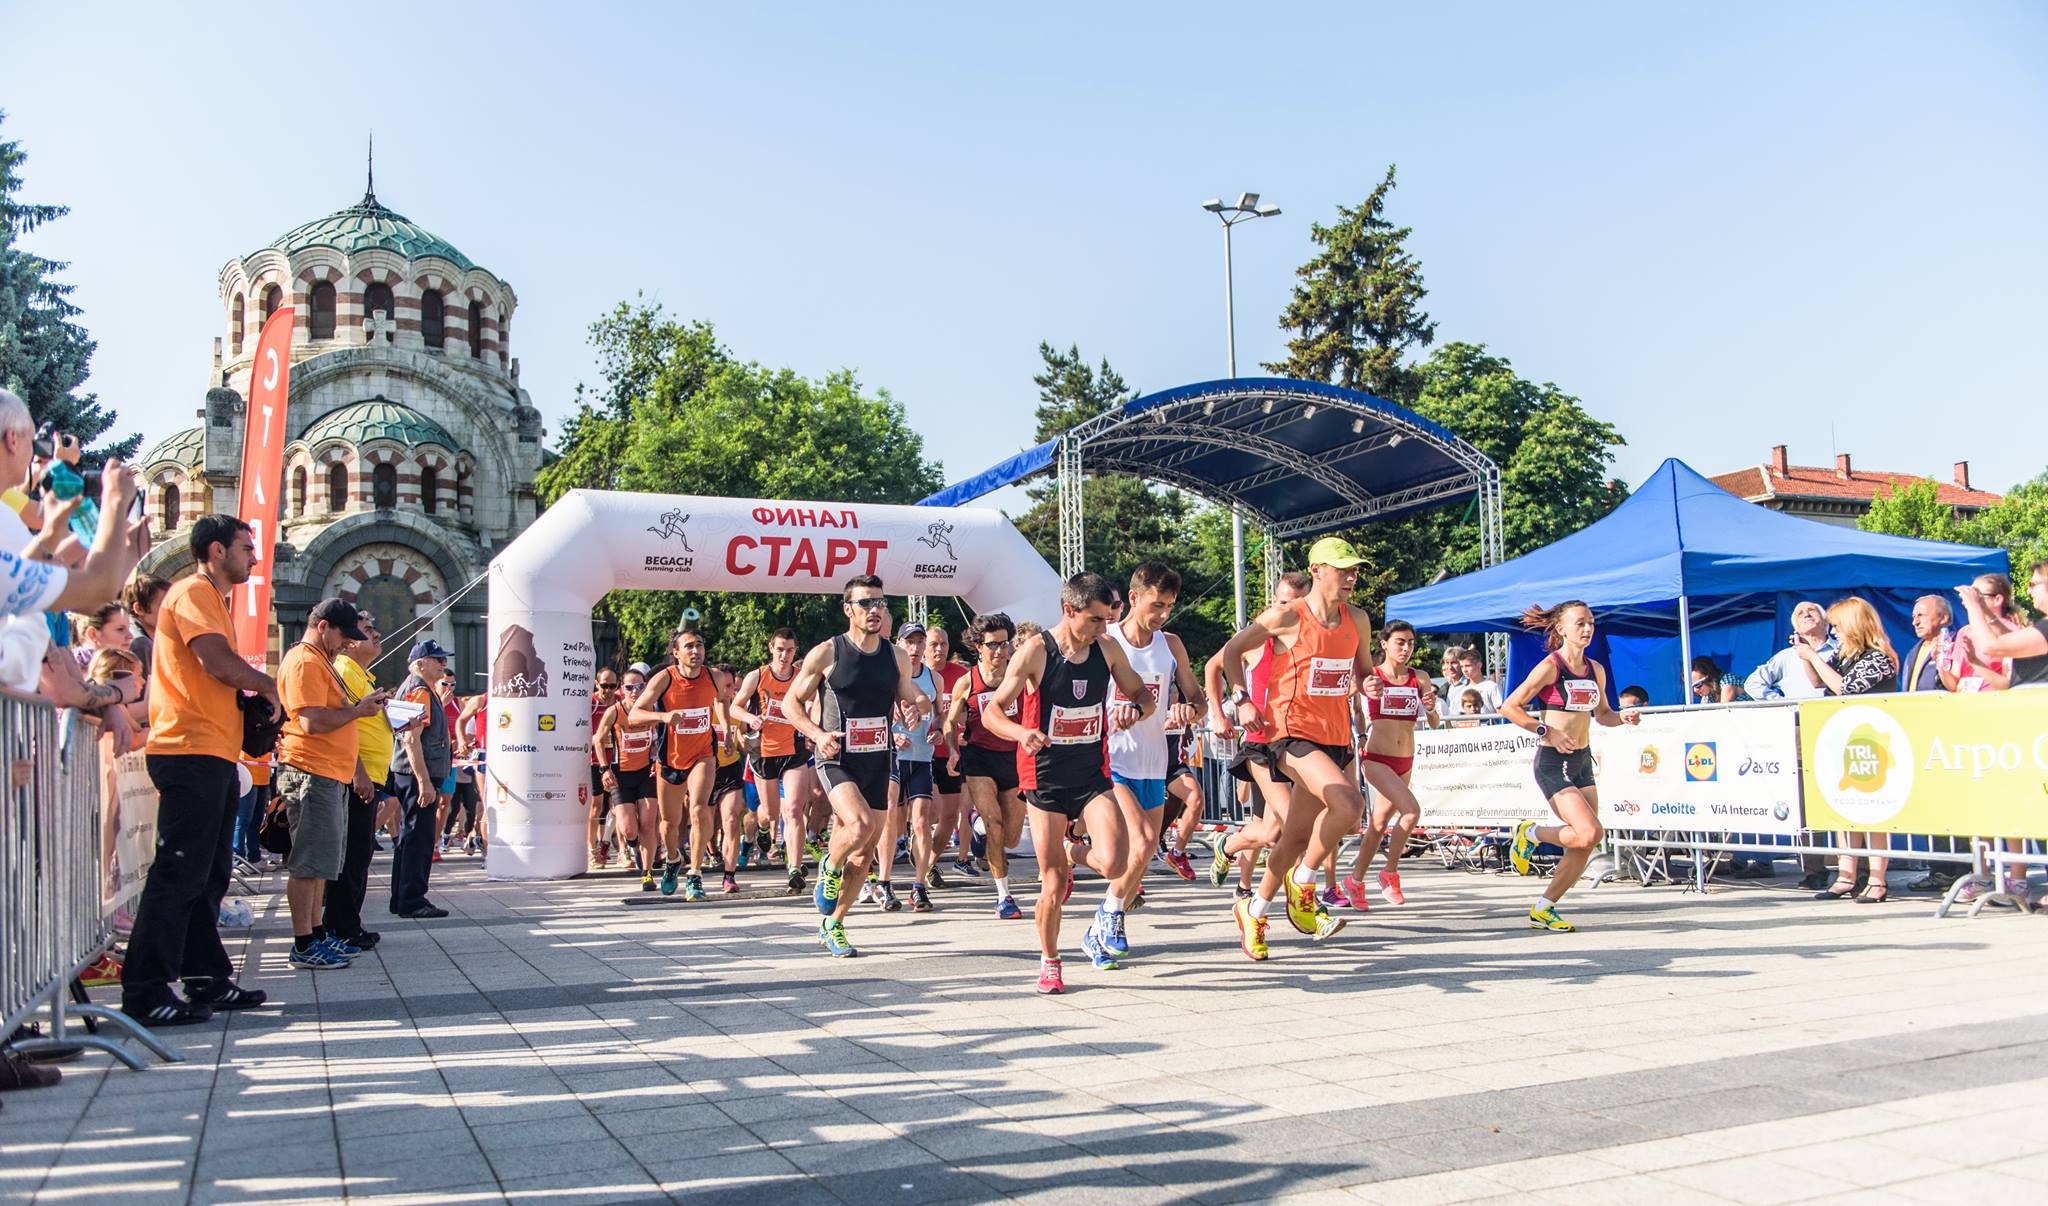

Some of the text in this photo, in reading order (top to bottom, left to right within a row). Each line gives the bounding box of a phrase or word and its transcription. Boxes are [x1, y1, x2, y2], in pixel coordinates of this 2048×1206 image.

[752, 507, 859, 529] ФИНАЛ
[645, 555, 693, 566] BEGACH
[725, 535, 888, 578] СТАРТ
[915, 563, 957, 573] BEGACH
[1405, 698, 1418, 710] 28
[698, 717, 708, 728] 20
[1082, 719, 1098, 736] 41
[874, 730, 886, 744] 50
[1437, 742, 1480, 757] маратон
[1481, 740, 1493, 752] на
[1923, 735, 2023, 779] Агро
[1752, 761, 1780, 774] asics
[1848, 760, 1880, 776] ART
[1711, 803, 1769, 816] ViA Intercar
